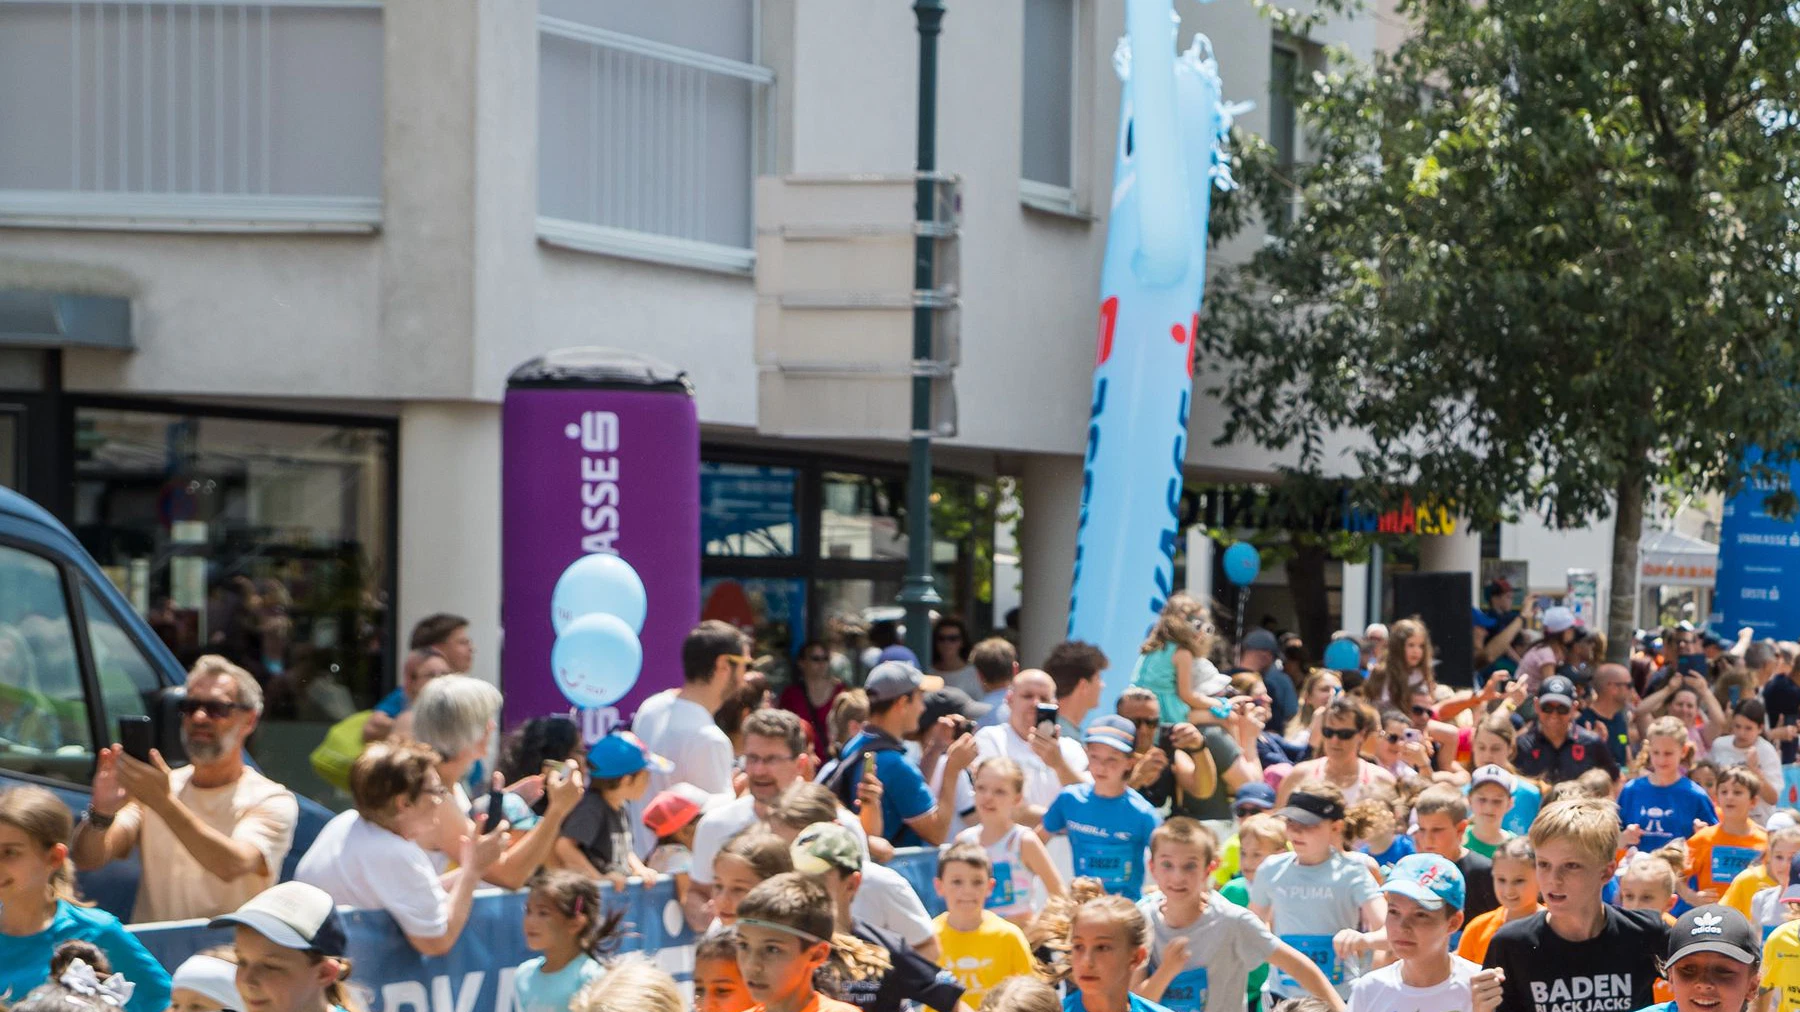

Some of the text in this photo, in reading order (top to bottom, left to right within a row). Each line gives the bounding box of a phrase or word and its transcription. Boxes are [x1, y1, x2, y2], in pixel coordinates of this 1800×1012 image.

[1290, 885, 1335, 900] PUMA
[1690, 922, 1723, 936] adidas
[1529, 973, 1633, 1004] BADEN
